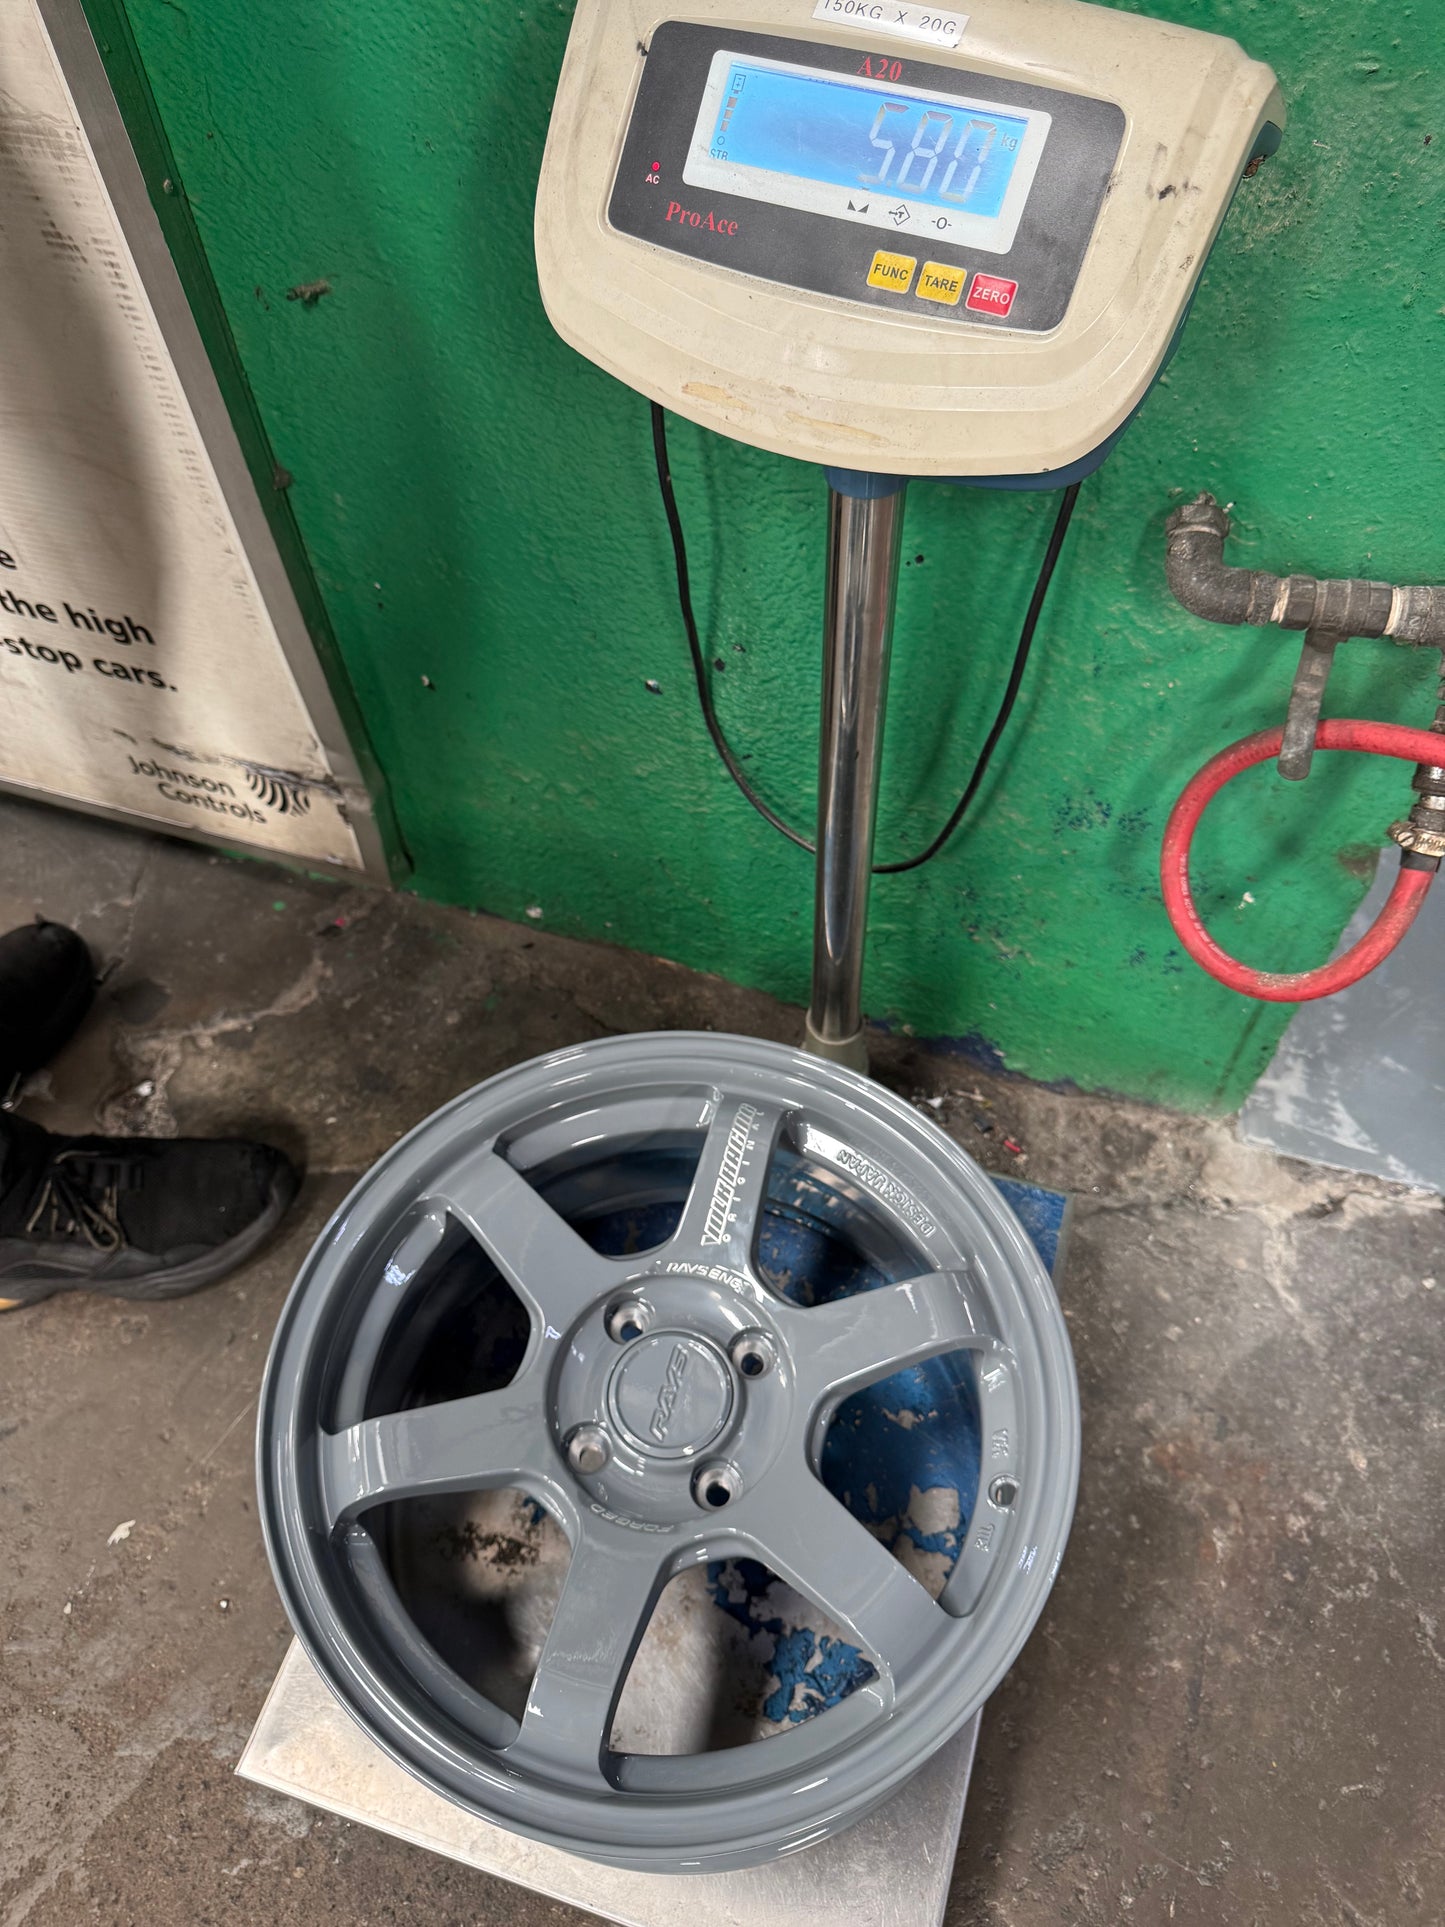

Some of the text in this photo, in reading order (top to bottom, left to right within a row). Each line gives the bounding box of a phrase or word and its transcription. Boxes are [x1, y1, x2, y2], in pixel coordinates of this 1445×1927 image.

[824, 0, 957, 35] 150KG X 20G
[856, 56, 903, 82] A20
[1001, 133, 1018, 152] kg
[645, 173, 661, 185] AC
[665, 200, 739, 236] ProAce
[874, 263, 909, 281] FUNC
[925, 274, 959, 292] TARE
[973, 286, 1010, 305] ZERO
[0, 589, 157, 645] the high
[93, 658, 178, 692] cars.
[128, 753, 236, 798] Johnson
[158, 782, 267, 824] Controls
[650, 1343, 689, 1443] RAYS
[590, 1503, 675, 1533] FORGED
